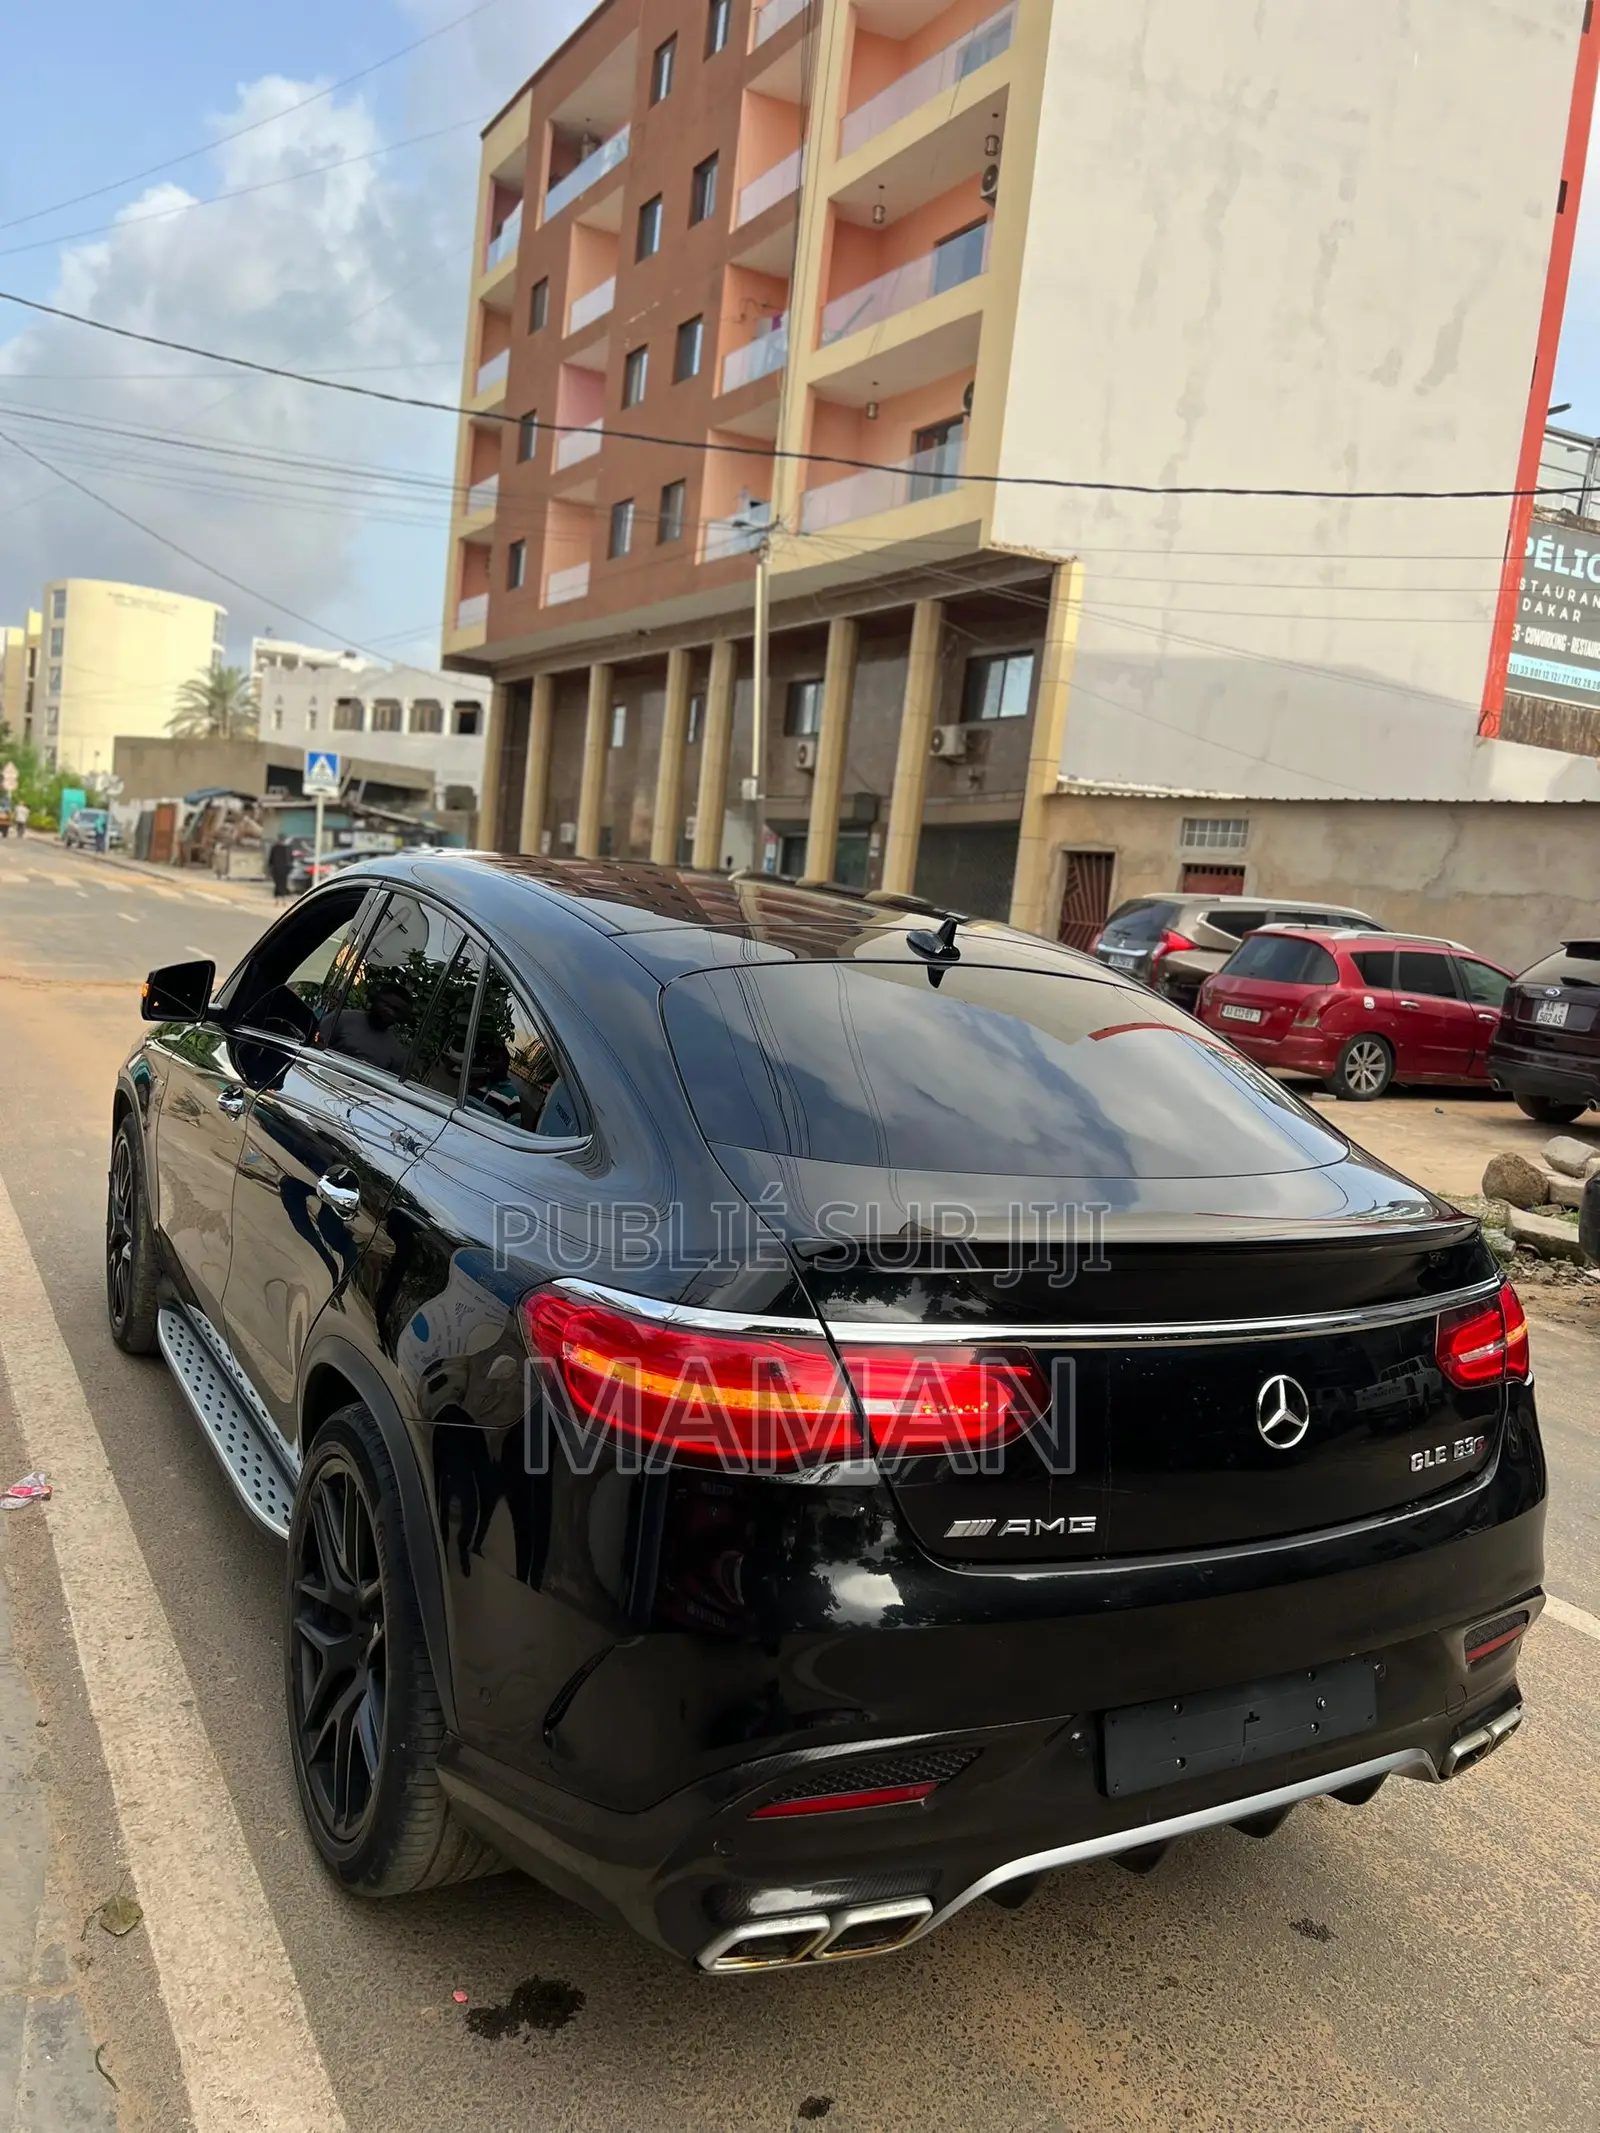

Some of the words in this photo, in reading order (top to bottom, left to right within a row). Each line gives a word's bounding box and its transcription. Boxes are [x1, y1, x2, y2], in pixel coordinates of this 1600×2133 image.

[1522, 597, 1582, 623] DAKAR
[1410, 1445, 1447, 1472] GLE
[997, 1516, 1097, 1536] AMG
